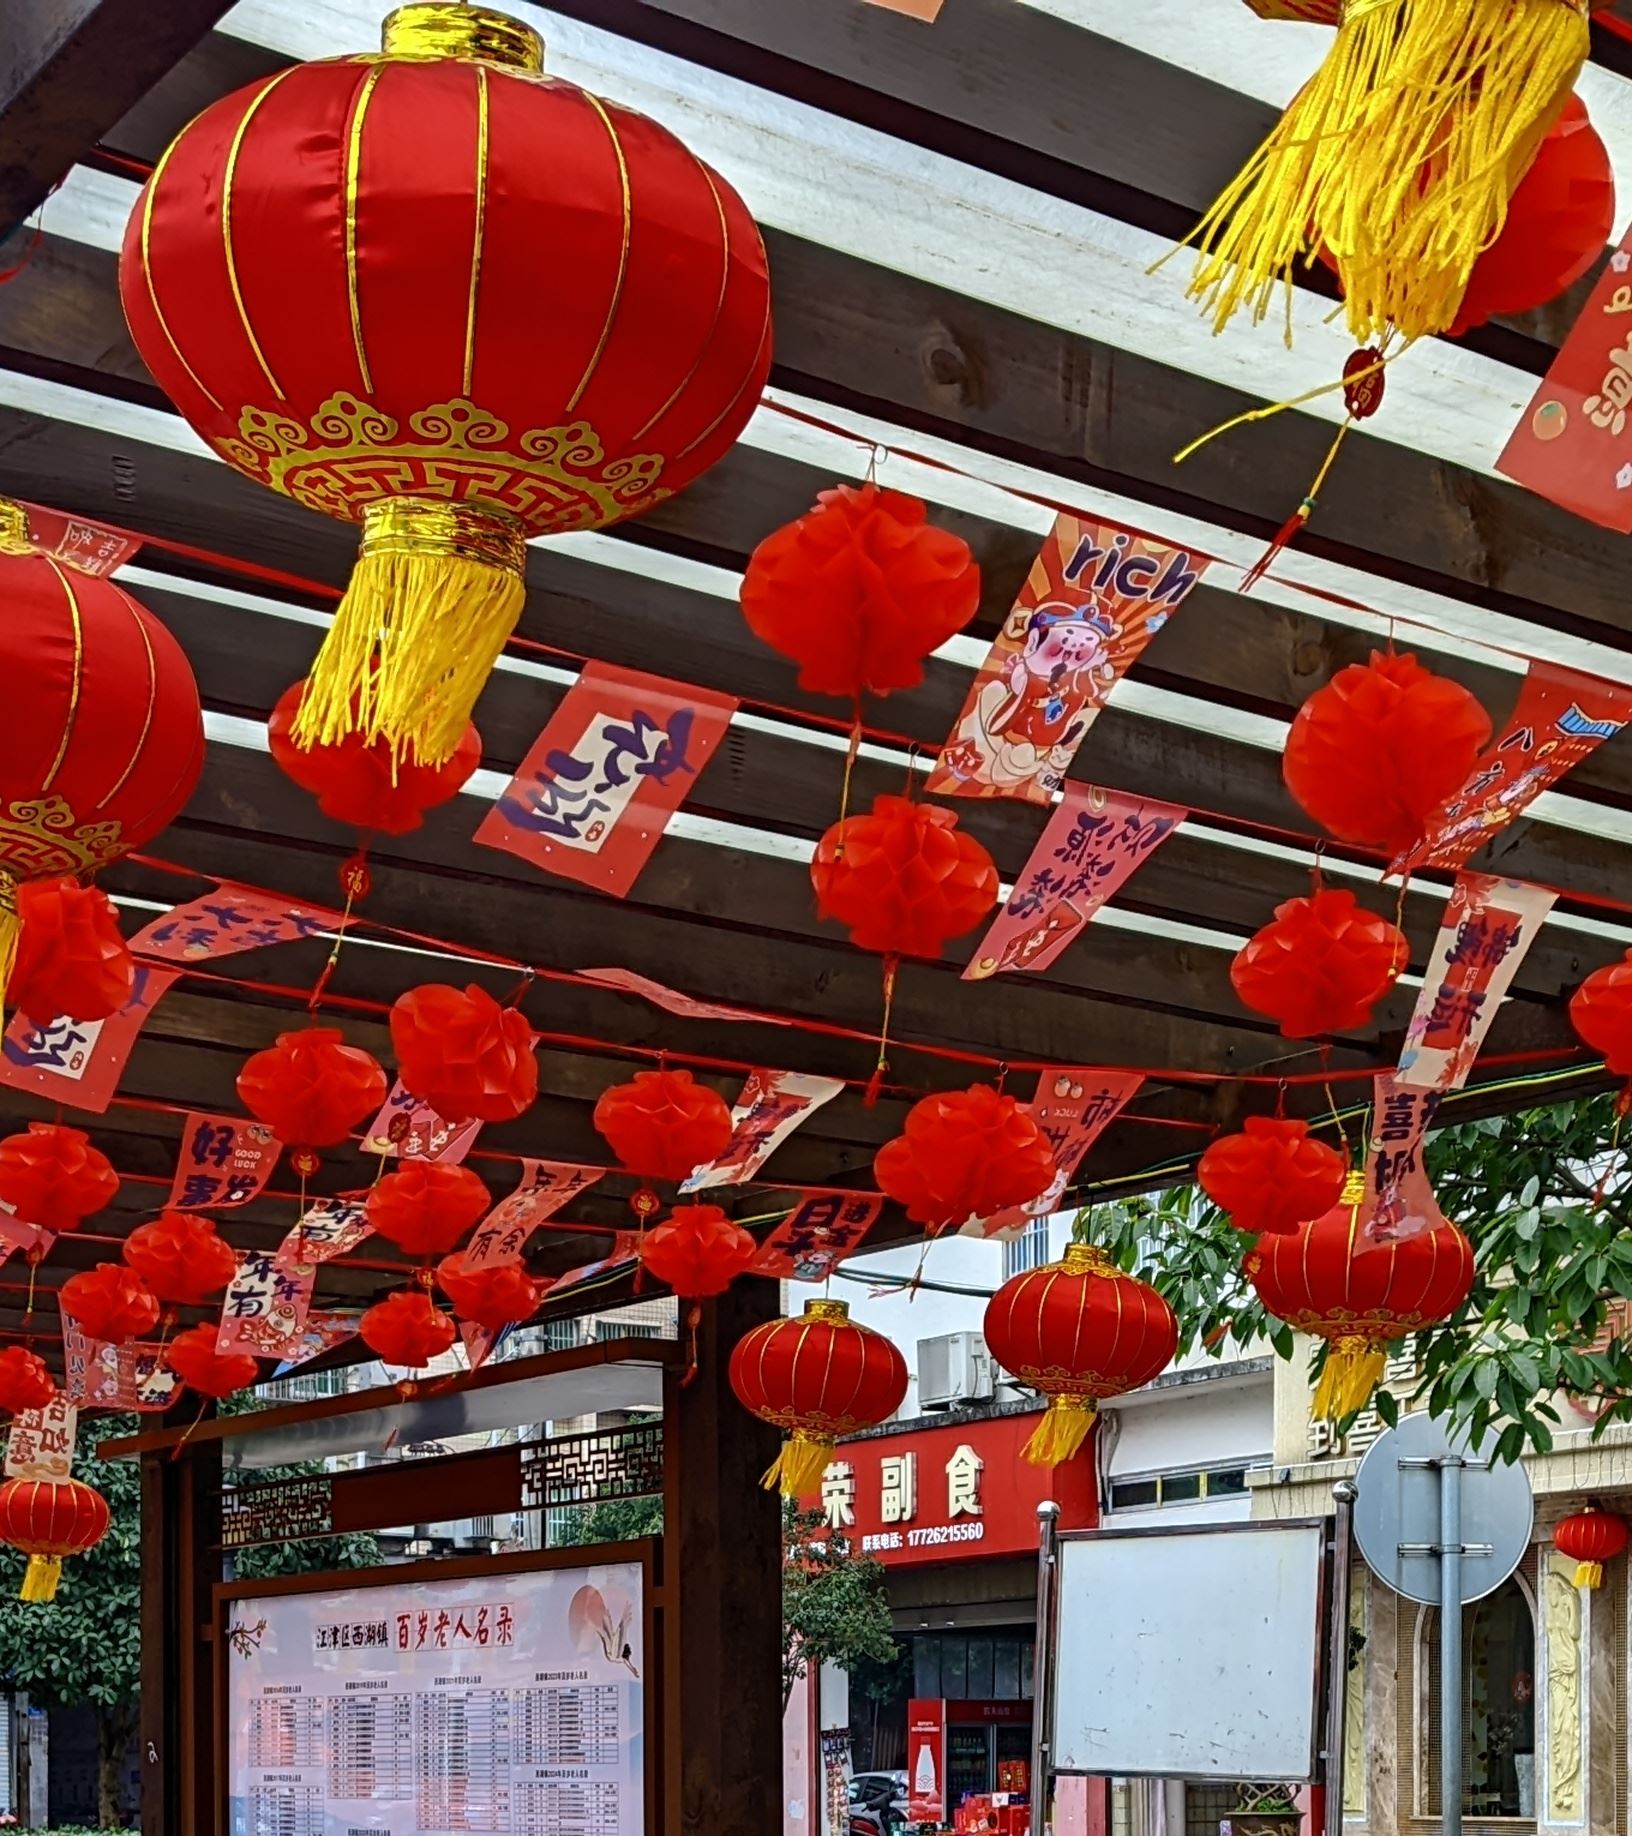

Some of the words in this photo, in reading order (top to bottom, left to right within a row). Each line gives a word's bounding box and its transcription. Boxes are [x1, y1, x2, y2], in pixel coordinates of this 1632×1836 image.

[1063, 533, 1199, 606] rich
[234, 1160, 257, 1169] LUCK
[235, 1149, 261, 1159] GOOD
[397, 1605, 513, 1651] 百岁老人名录
